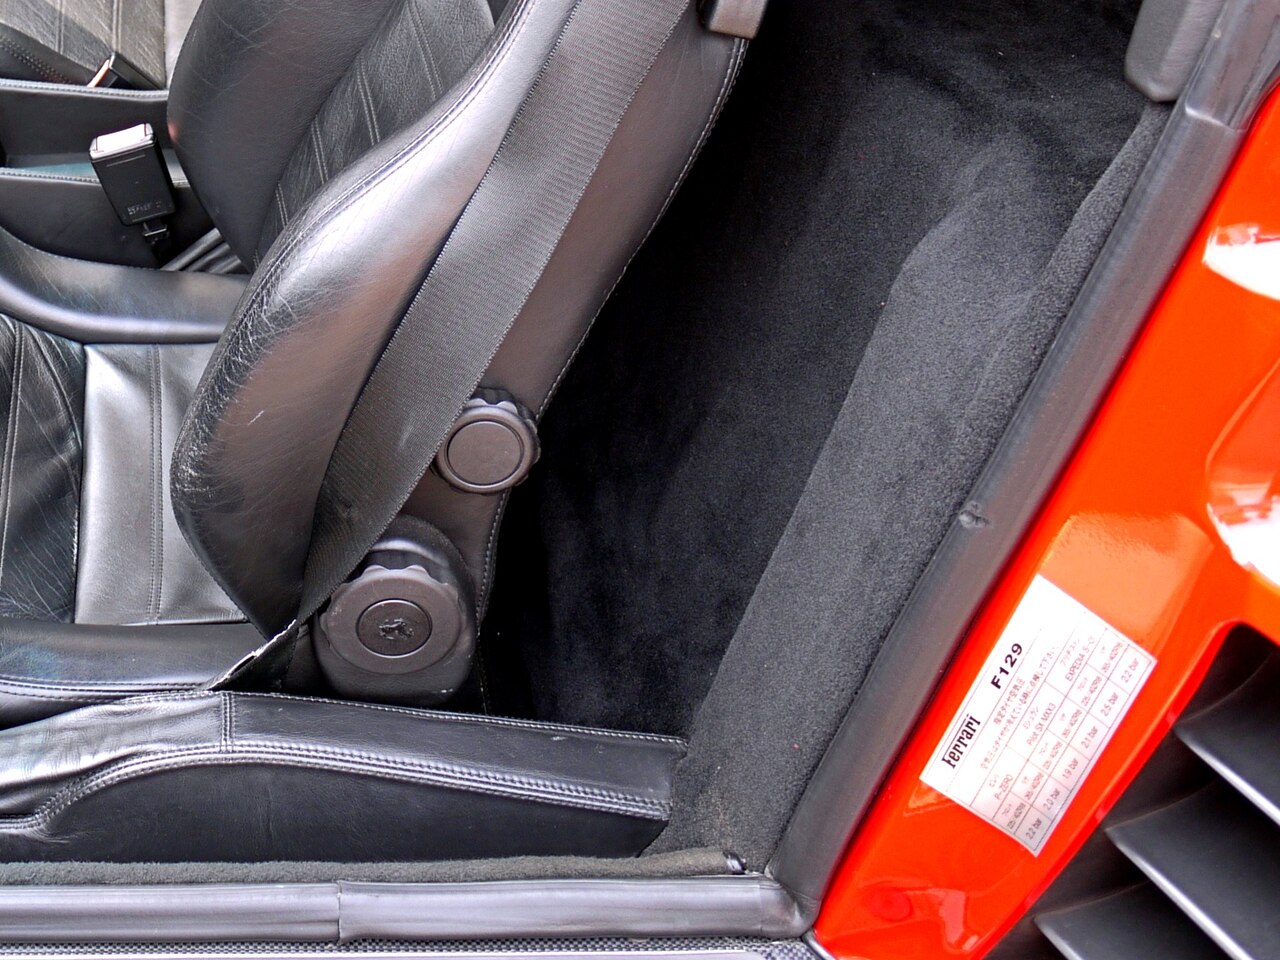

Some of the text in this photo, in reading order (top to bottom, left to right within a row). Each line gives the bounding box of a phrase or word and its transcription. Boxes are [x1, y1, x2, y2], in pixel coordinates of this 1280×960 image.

[1118, 655, 1141, 684] 2.2 bar
[939, 639, 1025, 769] Ferrari F129
[1098, 689, 1120, 717] 2.5 bar
[1085, 723, 1100, 739] bar
[1060, 755, 1080, 780] 1.9 bar
[1041, 785, 1061, 811] 2.0 bar
[1023, 815, 1043, 840] 2.2 bar
